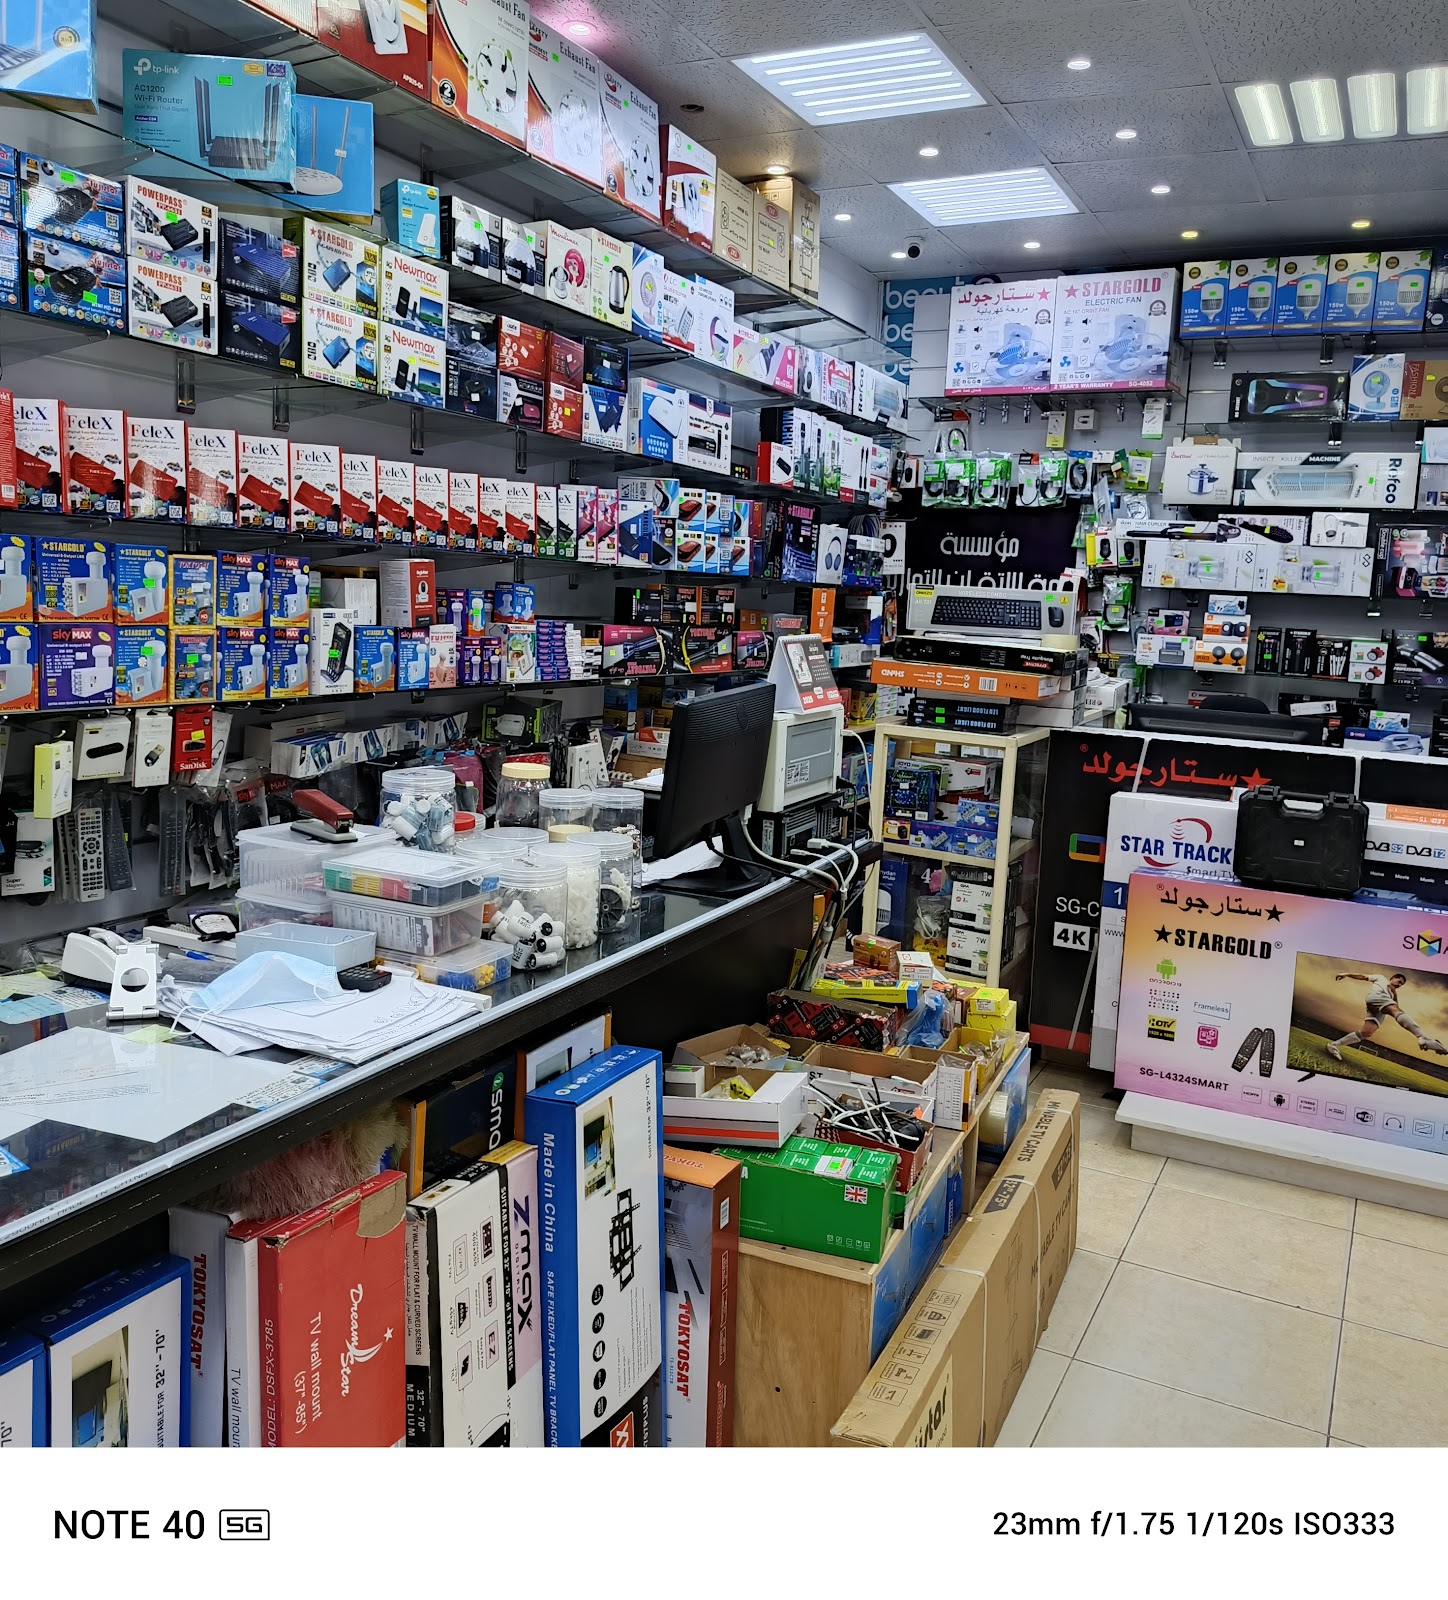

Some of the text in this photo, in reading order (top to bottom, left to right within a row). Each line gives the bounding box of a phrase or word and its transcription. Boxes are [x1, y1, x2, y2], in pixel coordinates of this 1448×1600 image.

[559, 42, 597, 74] Exhaust Fan
[152, 65, 179, 75] tp-link
[134, 84, 165, 94] AC1200
[134, 94, 184, 104] Wi-Fi Router
[630, 90, 658, 121] Exhaust Fan
[138, 185, 182, 208] POWERPASS
[317, 228, 354, 251] STARGOLD
[138, 266, 182, 286] POWERPASS
[394, 257, 438, 284] Newmax
[958, 288, 1034, 306] ستارجولد
[1082, 277, 1162, 297] STARGOLD
[1086, 296, 1142, 306] ELECTRIC FAN
[317, 308, 354, 328] STARGOLD
[392, 330, 436, 354] Newmax
[1410, 363, 1420, 395] FASHION
[13, 407, 48, 420] eleX
[68, 414, 113, 431] FeleX
[132, 424, 176, 440] FeleX
[242, 442, 280, 456] FeleX
[296, 450, 332, 464] FeleX
[344, 461, 369, 473] eleX
[450, 478, 472, 489] eleX
[479, 482, 500, 494] eleX
[507, 487, 529, 498] eleX
[50, 542, 86, 552] STARGOLD
[940, 531, 1020, 562] مؤسسة
[180, 762, 207, 770] SanDisk
[1082, 751, 1238, 788] ستارجولد
[270, 780, 288, 792] MAX
[1120, 834, 1232, 866] STAR TRACK
[1366, 841, 1404, 854] DVB S2
[1406, 846, 1446, 858] DVB T2
[1186, 866, 1218, 876] Smart
[981, 890, 992, 898] 7W
[1160, 888, 1262, 917] ستارجولد
[1056, 928, 1086, 946] 4K
[1174, 928, 1272, 960] STARGOLD
[1194, 1002, 1229, 1014] Frameless
[1139, 1066, 1230, 1092] SG-L4324SMART
[1032, 1130, 1046, 1141] TV
[1018, 1140, 1036, 1162] CARTS
[544, 1132, 556, 1252] Made in China
[412, 1224, 418, 1234] TV
[500, 1186, 508, 1232] SUITABLE
[506, 1312, 512, 1325] TV
[514, 1195, 533, 1335] Zmax
[190, 1254, 206, 1370] TOKYOSAT
[350, 1284, 364, 1348] Dream
[548, 1296, 556, 1355] FIXED/FLAT
[264, 1318, 276, 1396] DSFX-3785
[676, 1302, 692, 1396] TOKYOSAT
[310, 1312, 322, 1421] TV wall mount
[341, 1352, 355, 1397] Star
[231, 1368, 242, 1447] TV wall moun
[407, 1384, 416, 1436] MEDIUM
[550, 1394, 556, 1408] TV
